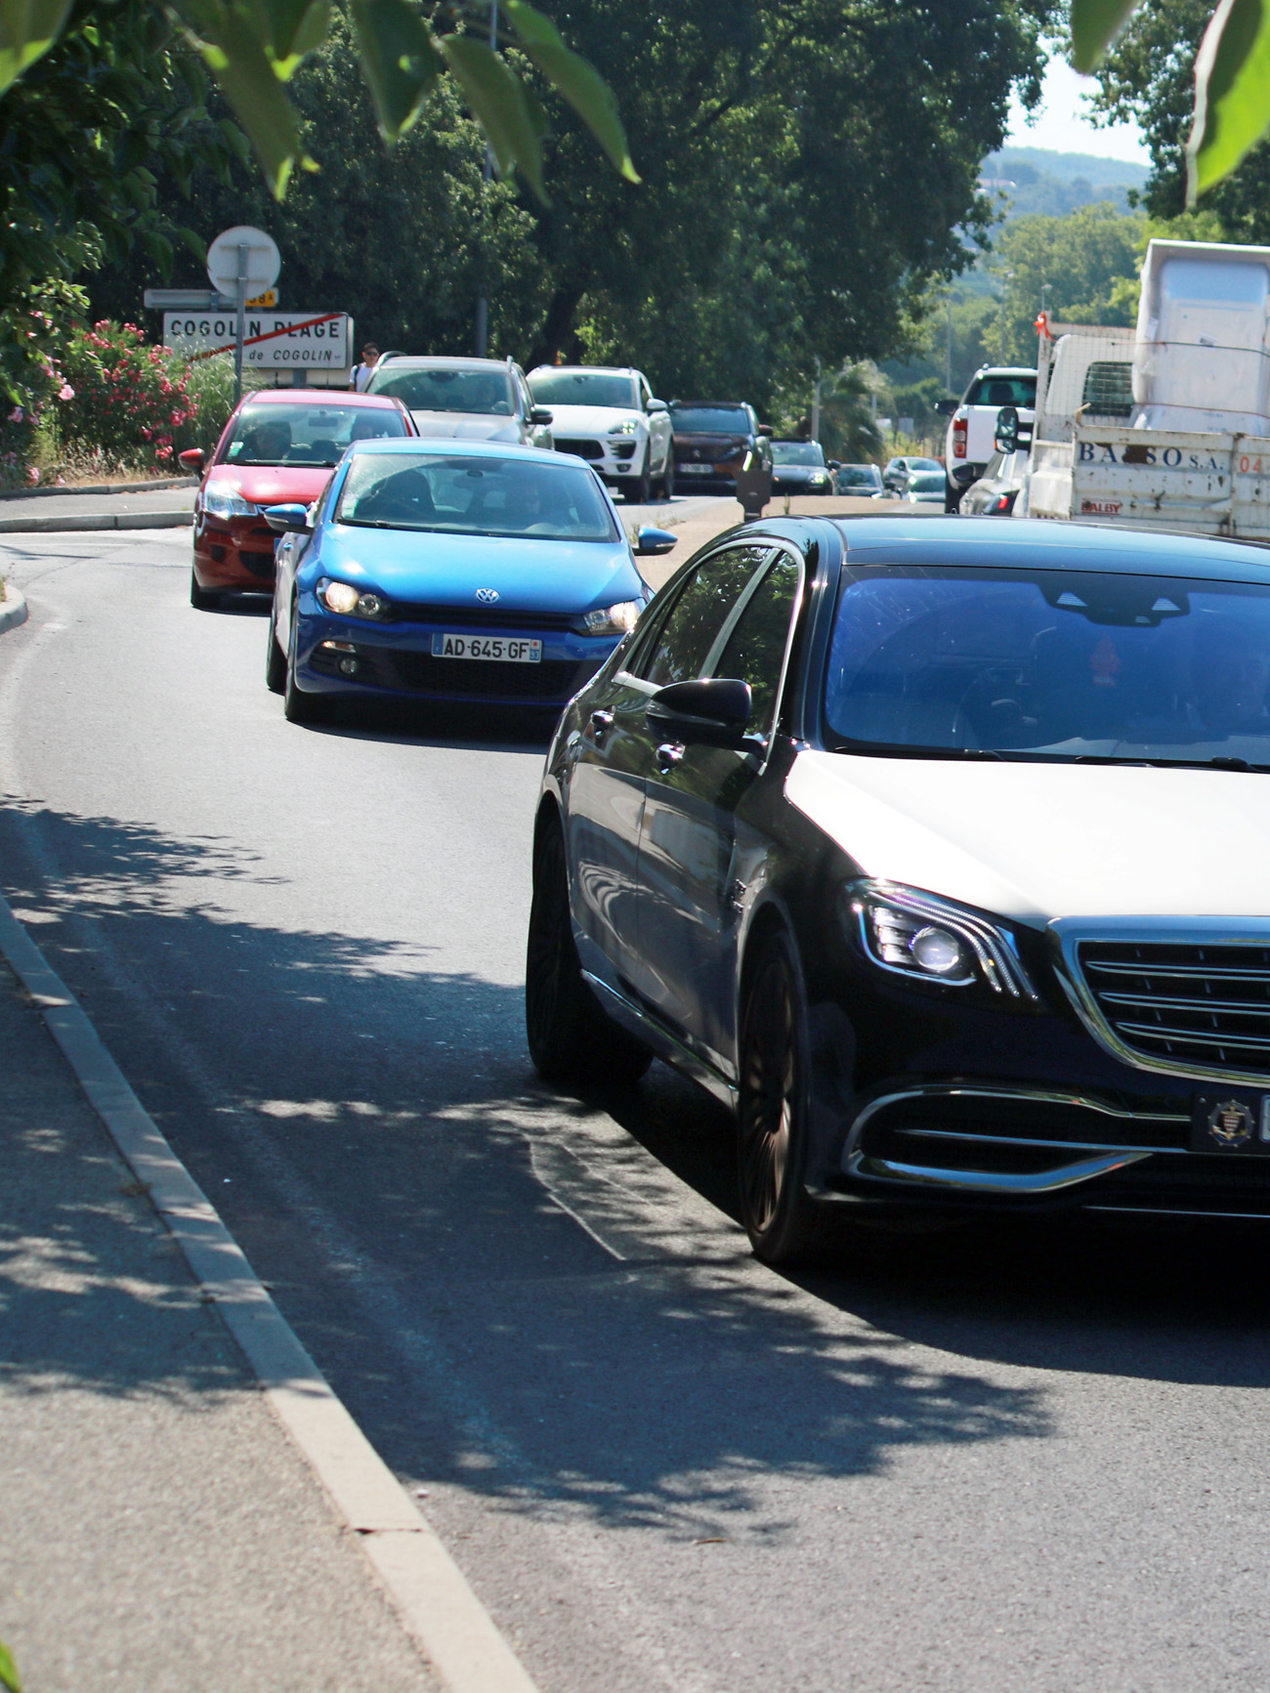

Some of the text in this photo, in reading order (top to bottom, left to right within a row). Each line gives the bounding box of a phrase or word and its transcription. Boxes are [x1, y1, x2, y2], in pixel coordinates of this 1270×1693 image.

[171, 320, 260, 337] COGOLN
[249, 350, 264, 360] de
[273, 350, 332, 361] COGOLIN
[1080, 442, 1181, 467] BASO
[1240, 456, 1262, 474] 04
